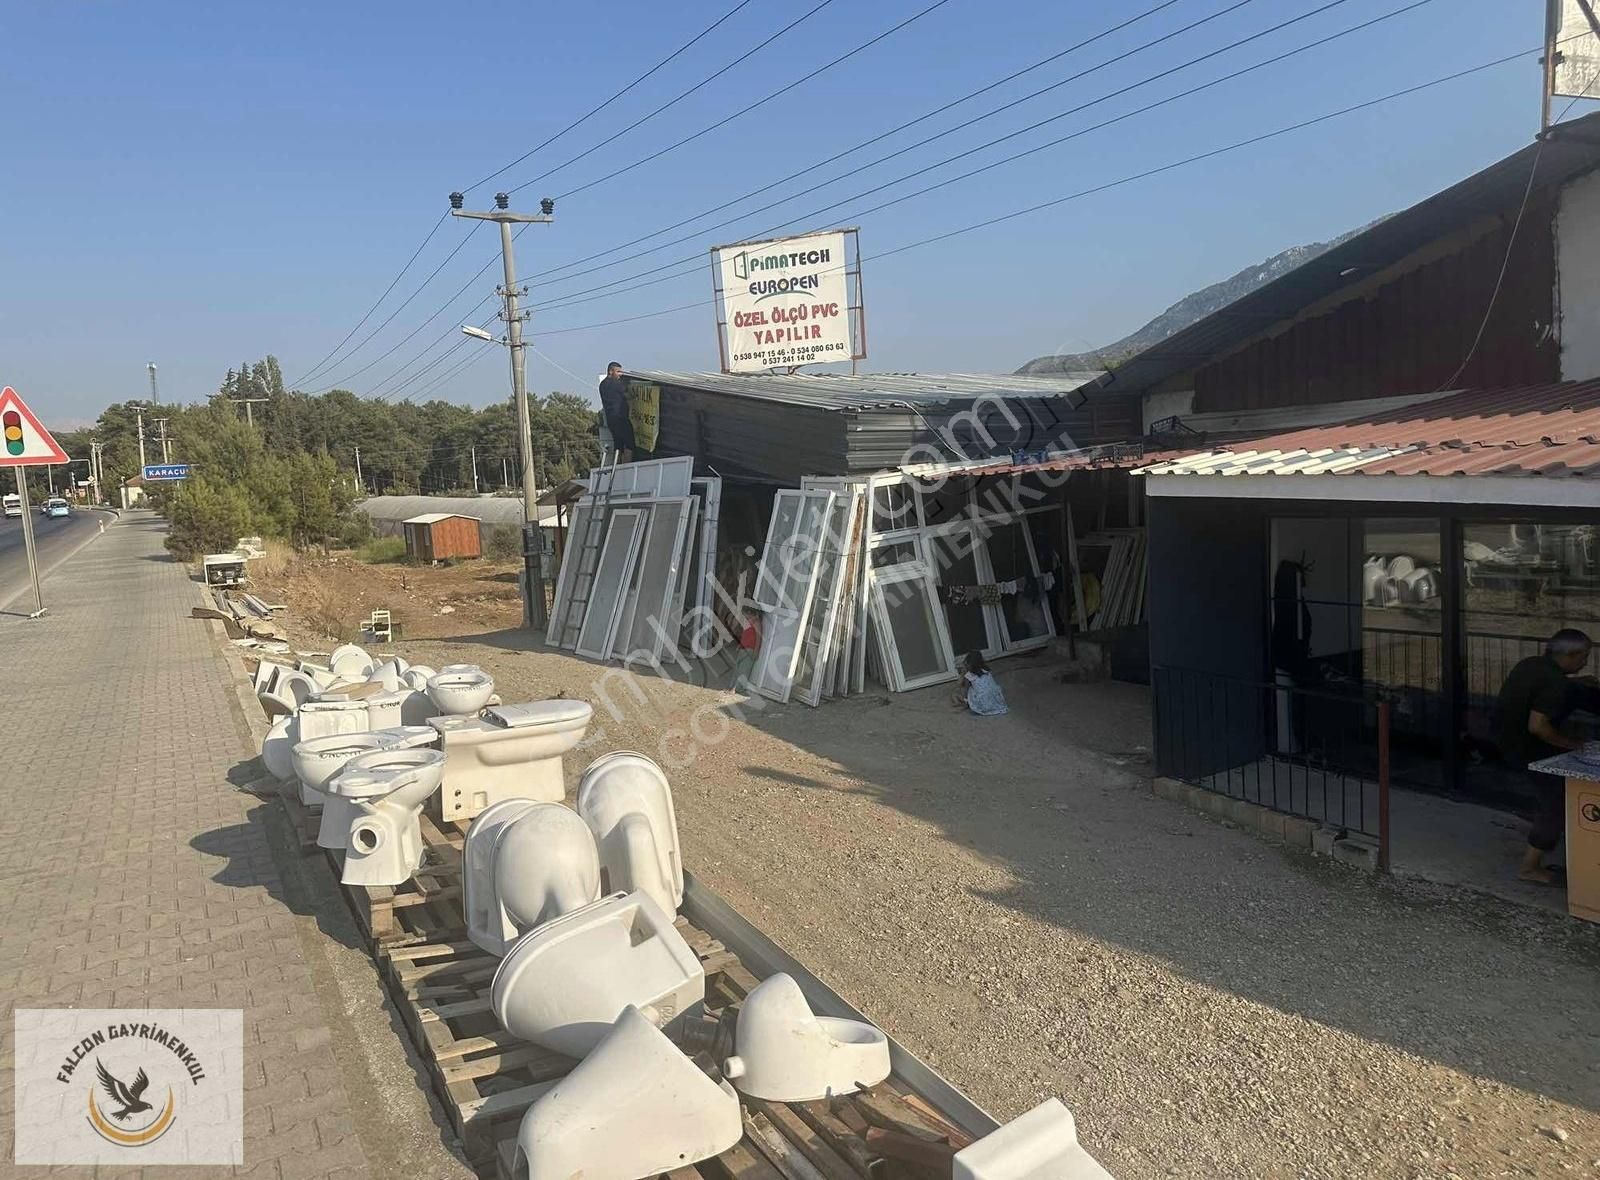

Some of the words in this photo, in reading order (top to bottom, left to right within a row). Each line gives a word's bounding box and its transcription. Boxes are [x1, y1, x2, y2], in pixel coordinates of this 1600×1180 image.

[749, 274, 819, 295] EUROPEN
[734, 311, 768, 327] ÖZEL
[772, 304, 807, 325] ÖLÇÜ
[811, 302, 839, 319] PVC
[754, 324, 821, 345] YAPILIR
[782, 355, 794, 363] 241
[806, 353, 815, 361] 02
